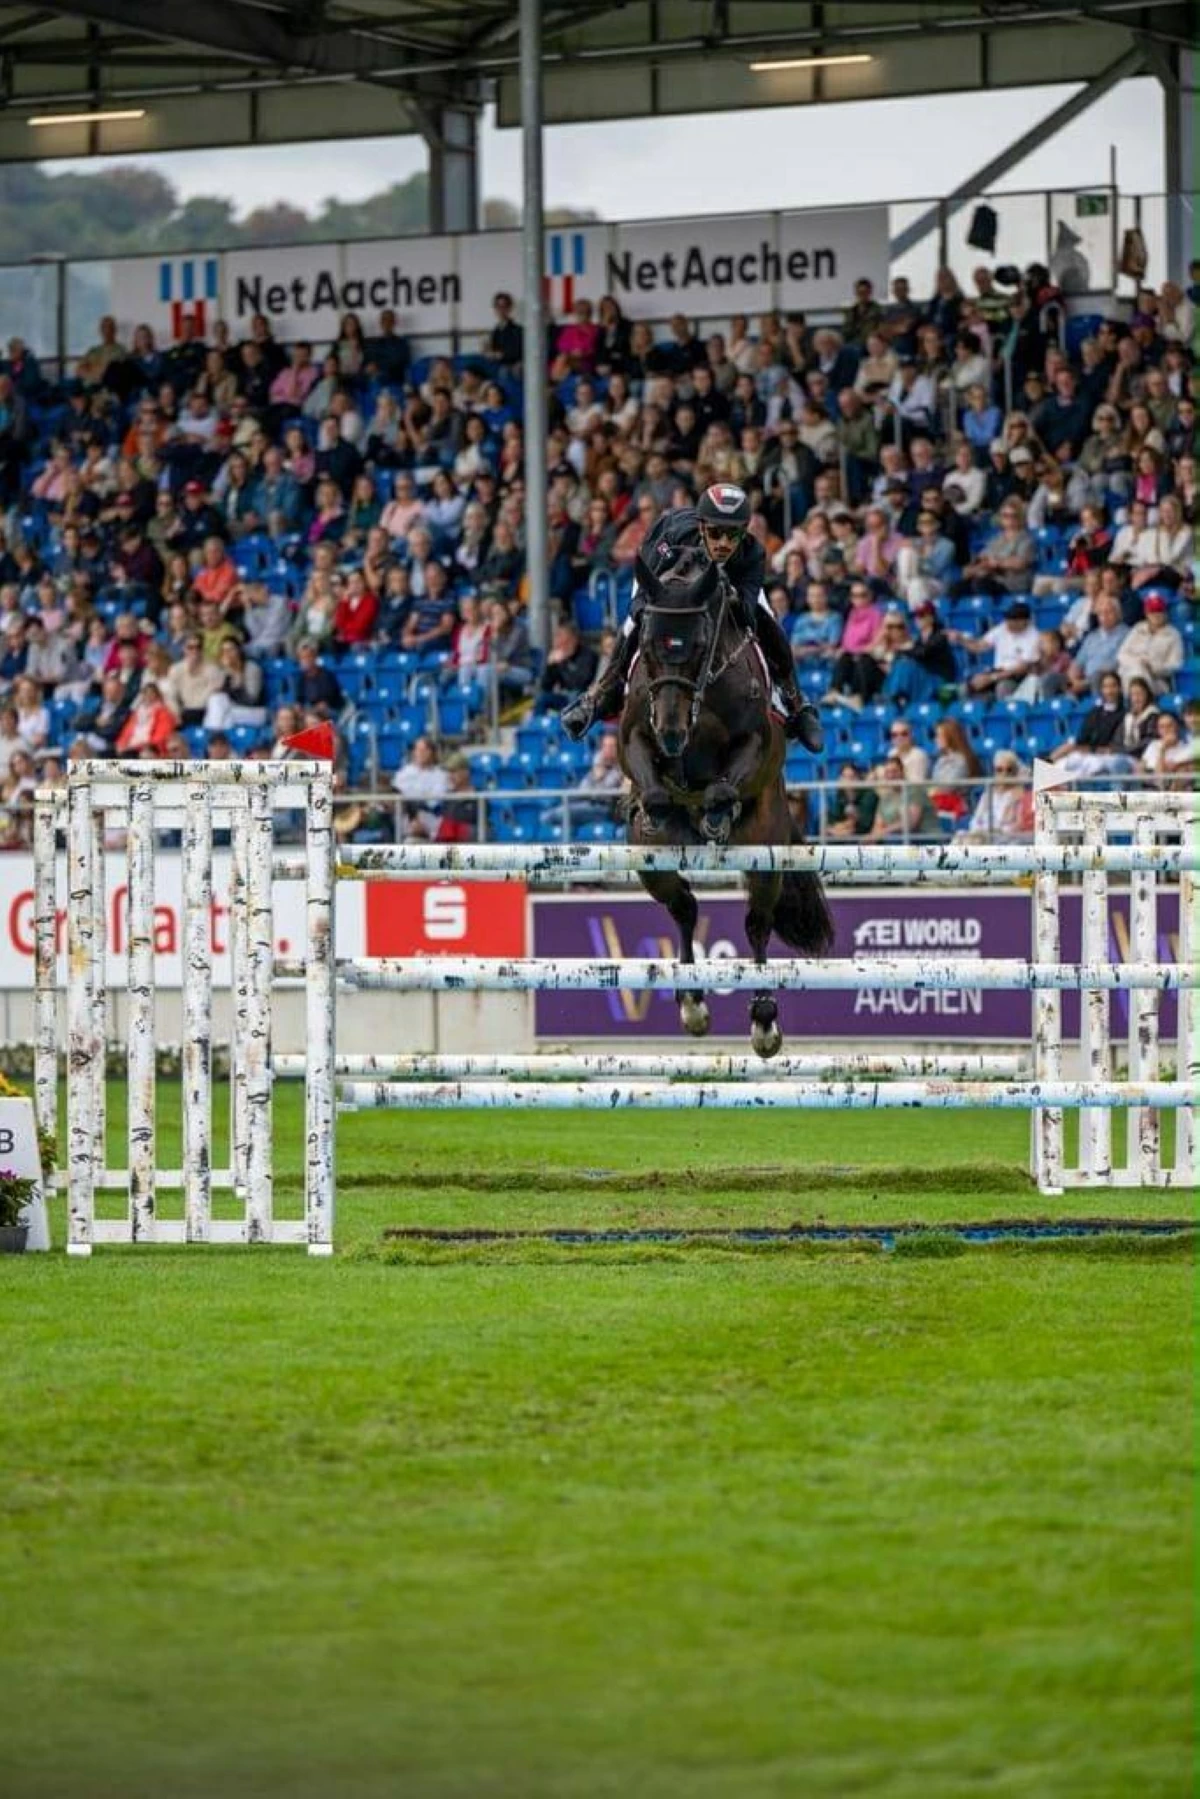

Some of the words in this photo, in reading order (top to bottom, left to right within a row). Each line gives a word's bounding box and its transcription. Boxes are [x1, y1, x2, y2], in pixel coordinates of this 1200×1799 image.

[605, 241, 836, 291] NetAachen
[236, 266, 461, 316] NetAachen
[903, 919, 982, 946] WORLD
[854, 987, 982, 1015] AACHEN
